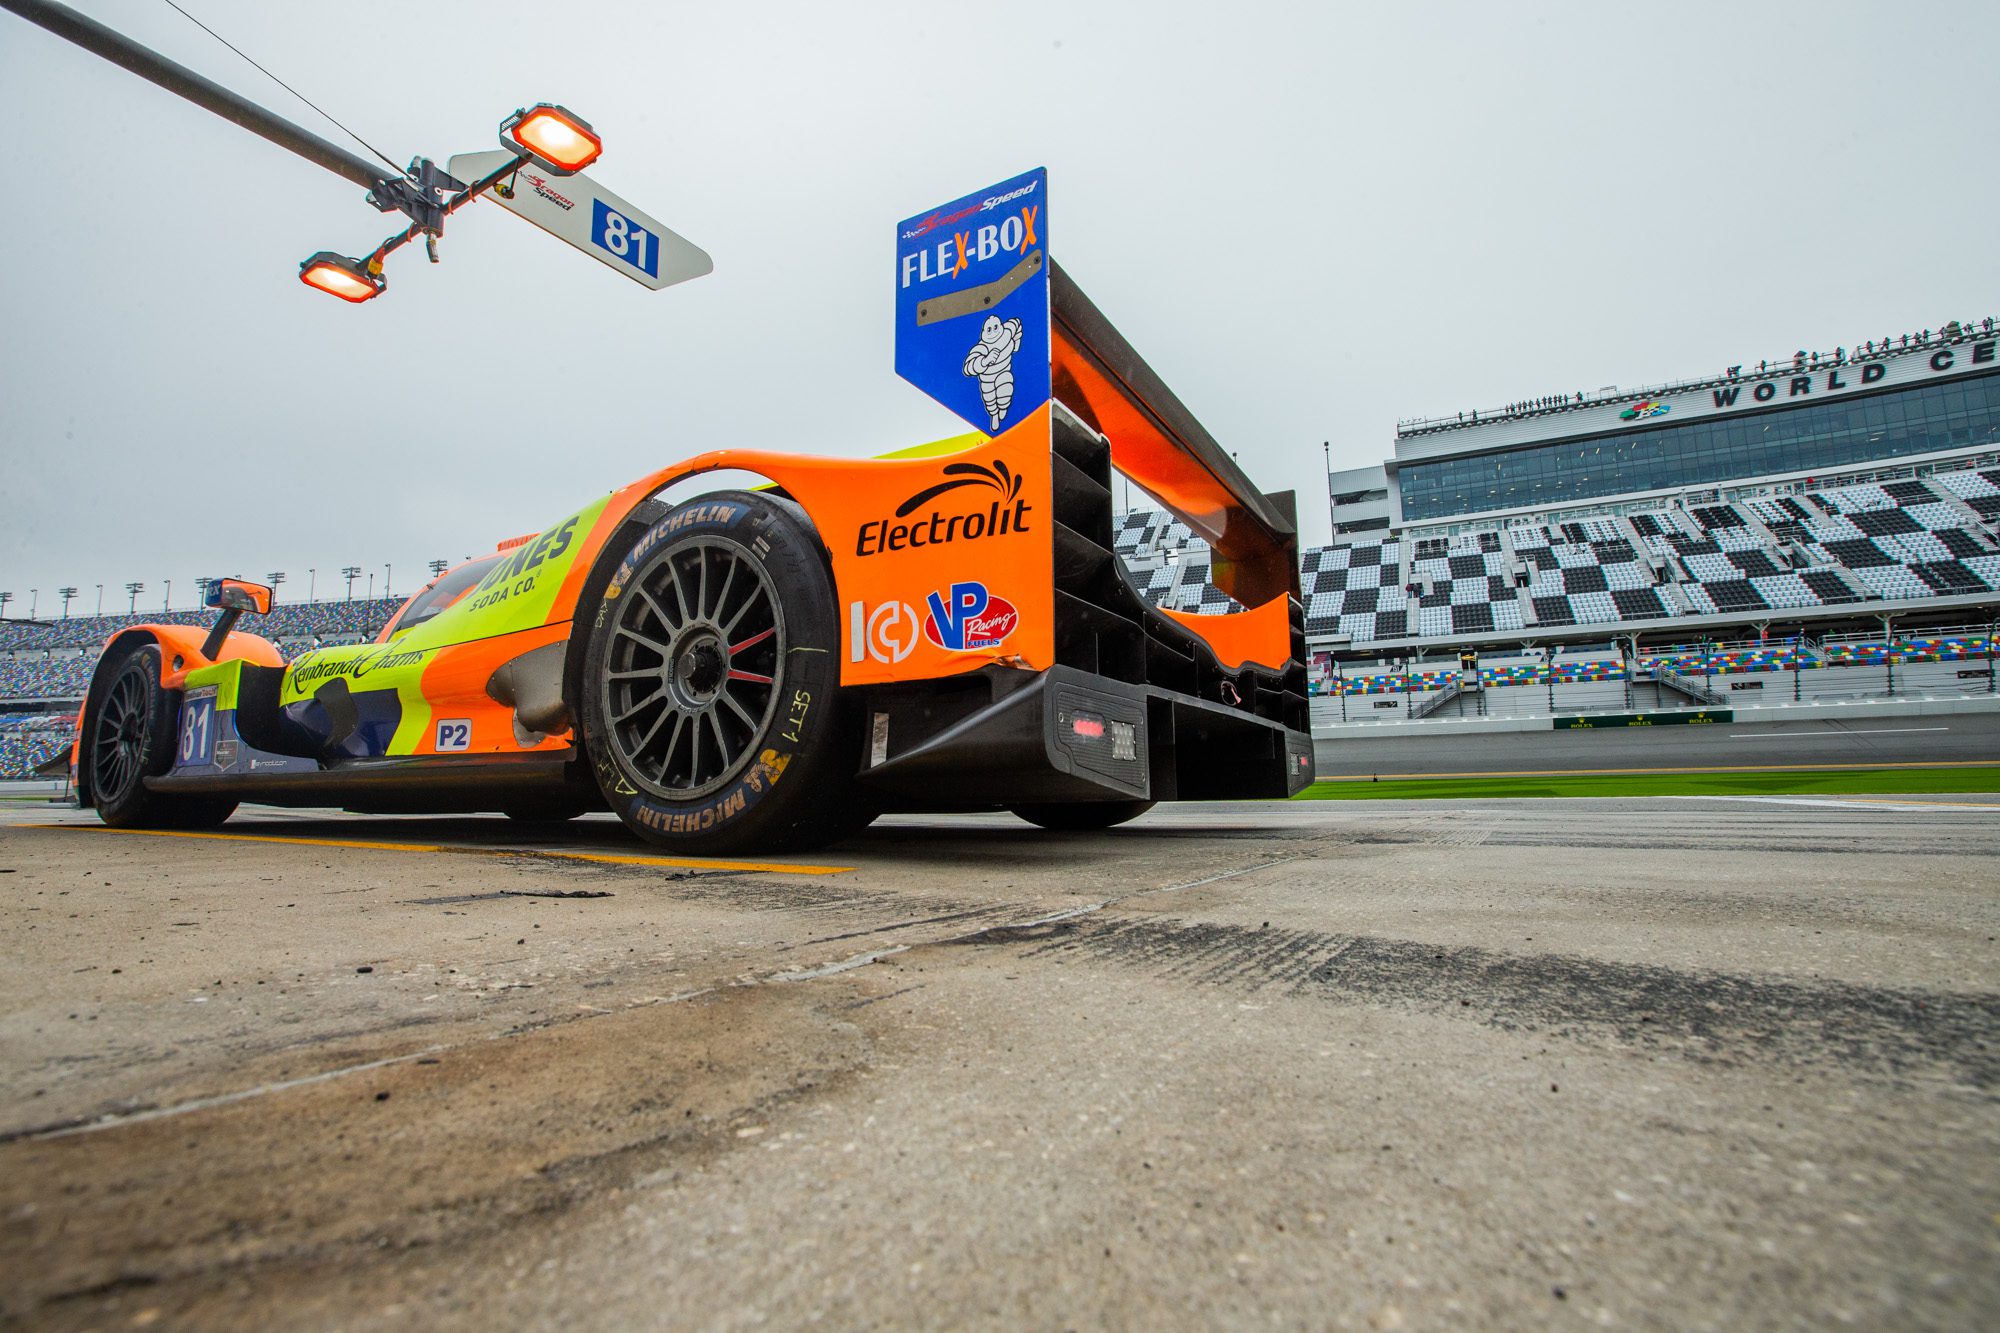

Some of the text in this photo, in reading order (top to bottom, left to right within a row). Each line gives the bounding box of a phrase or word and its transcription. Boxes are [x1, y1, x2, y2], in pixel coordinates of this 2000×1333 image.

[533, 187, 572, 211] Speed
[604, 211, 647, 270] 81
[902, 205, 1038, 288] FLEX-BOX
[1713, 363, 1886, 408] WORLD
[633, 505, 737, 563] MICHELIN
[856, 499, 1032, 557] Electrolit
[465, 515, 580, 600] JONES
[469, 576, 535, 612] SODA CO.
[927, 581, 989, 651] VP
[967, 612, 1016, 640] Racing
[967, 638, 1000, 648] FUELS
[286, 637, 423, 694] Rembrandt Charms
[183, 703, 210, 761] 81
[439, 724, 468, 746] P2
[782, 689, 811, 743] SET 1
[636, 787, 747, 833] MICHELIN
